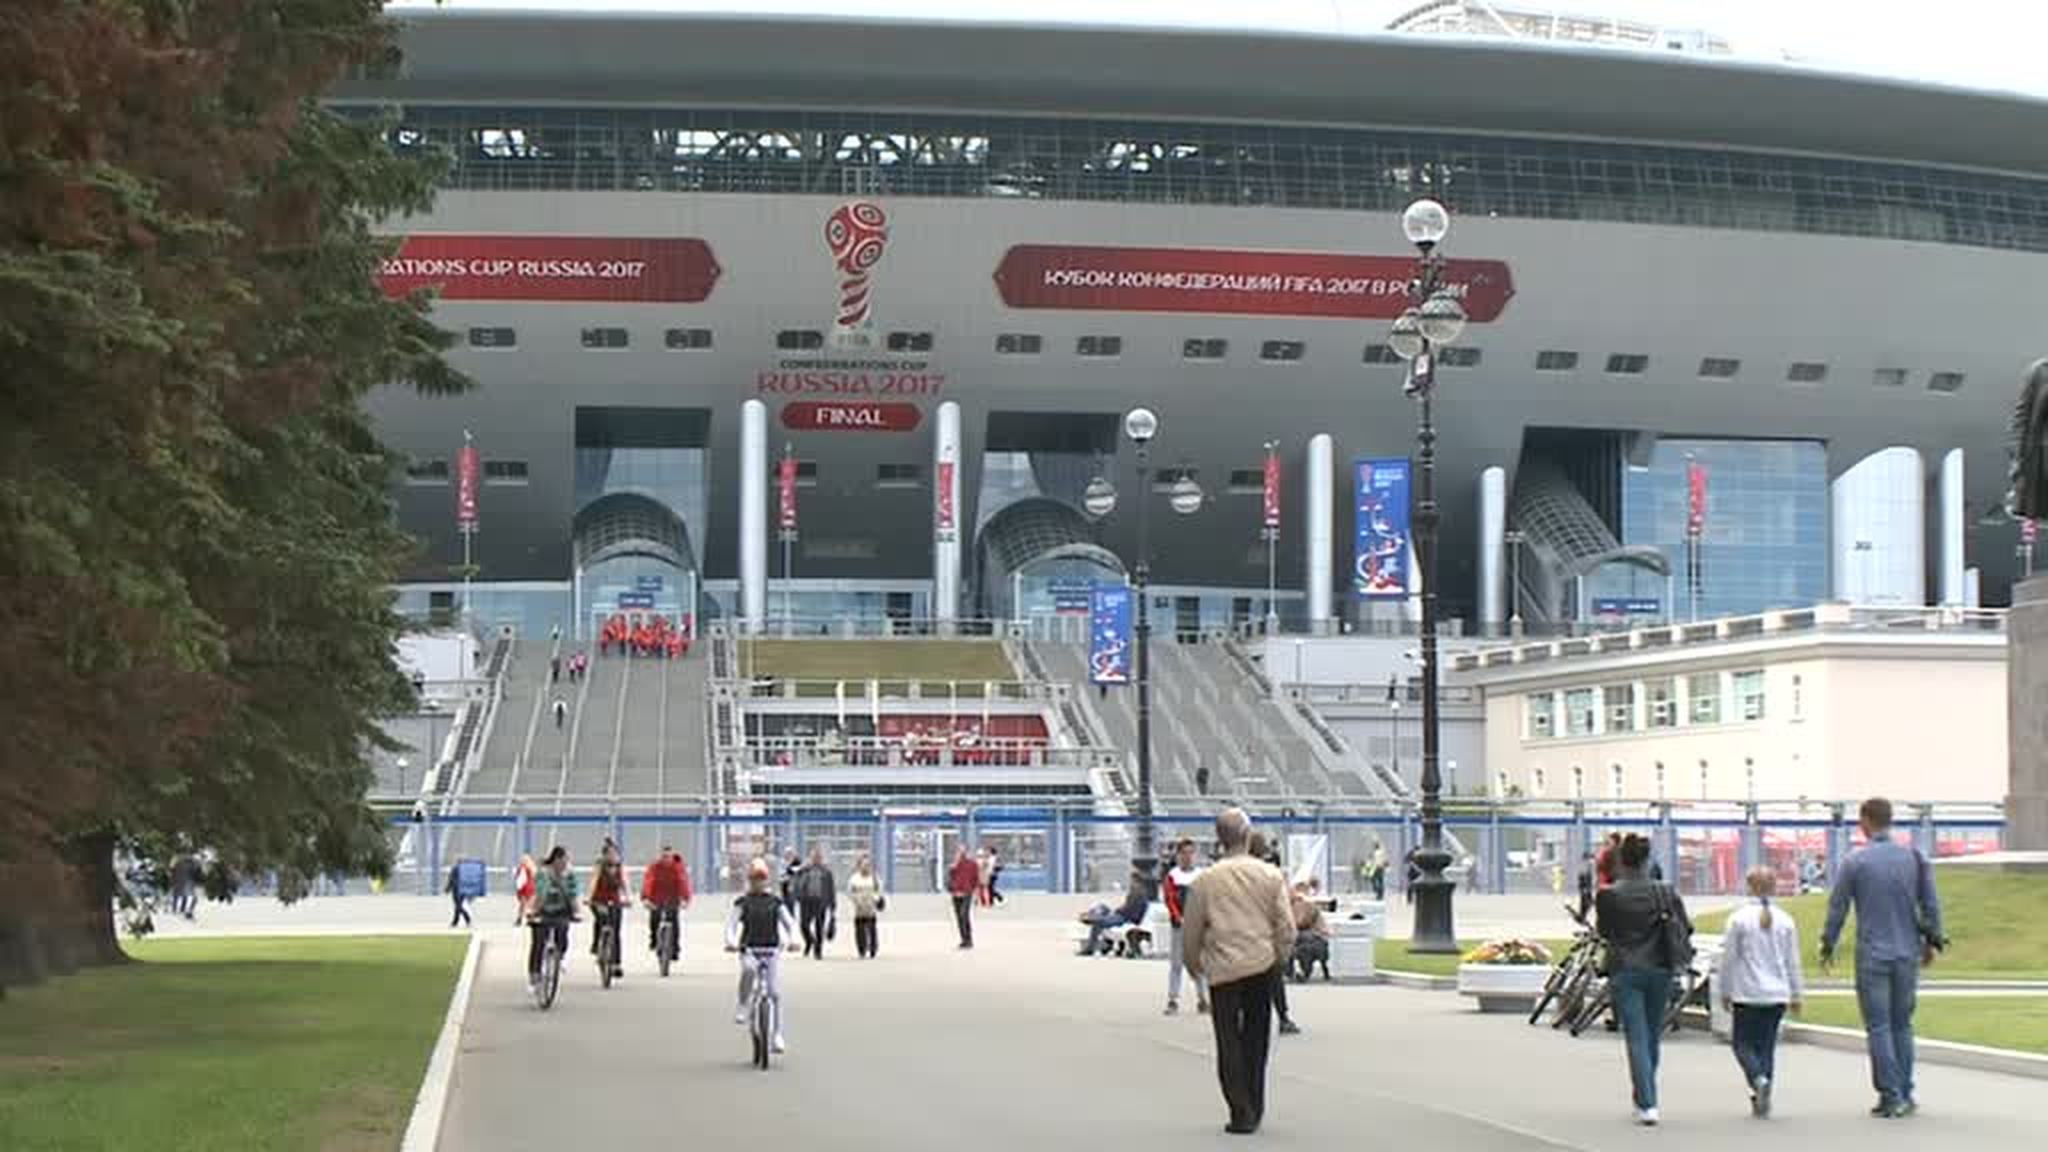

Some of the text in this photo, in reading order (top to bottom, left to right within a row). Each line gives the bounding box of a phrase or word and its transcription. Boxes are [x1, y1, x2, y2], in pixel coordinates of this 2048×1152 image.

[470, 258, 513, 276] CUP
[518, 260, 596, 278] RUSSIA
[599, 261, 644, 278] 2017
[1044, 269, 1115, 286] КУБОК
[1283, 274, 1323, 293] FIFA
[1326, 278, 1370, 295] 2017
[757, 373, 945, 396] RUSSIA 2017
[816, 406, 887, 425] FINAL
